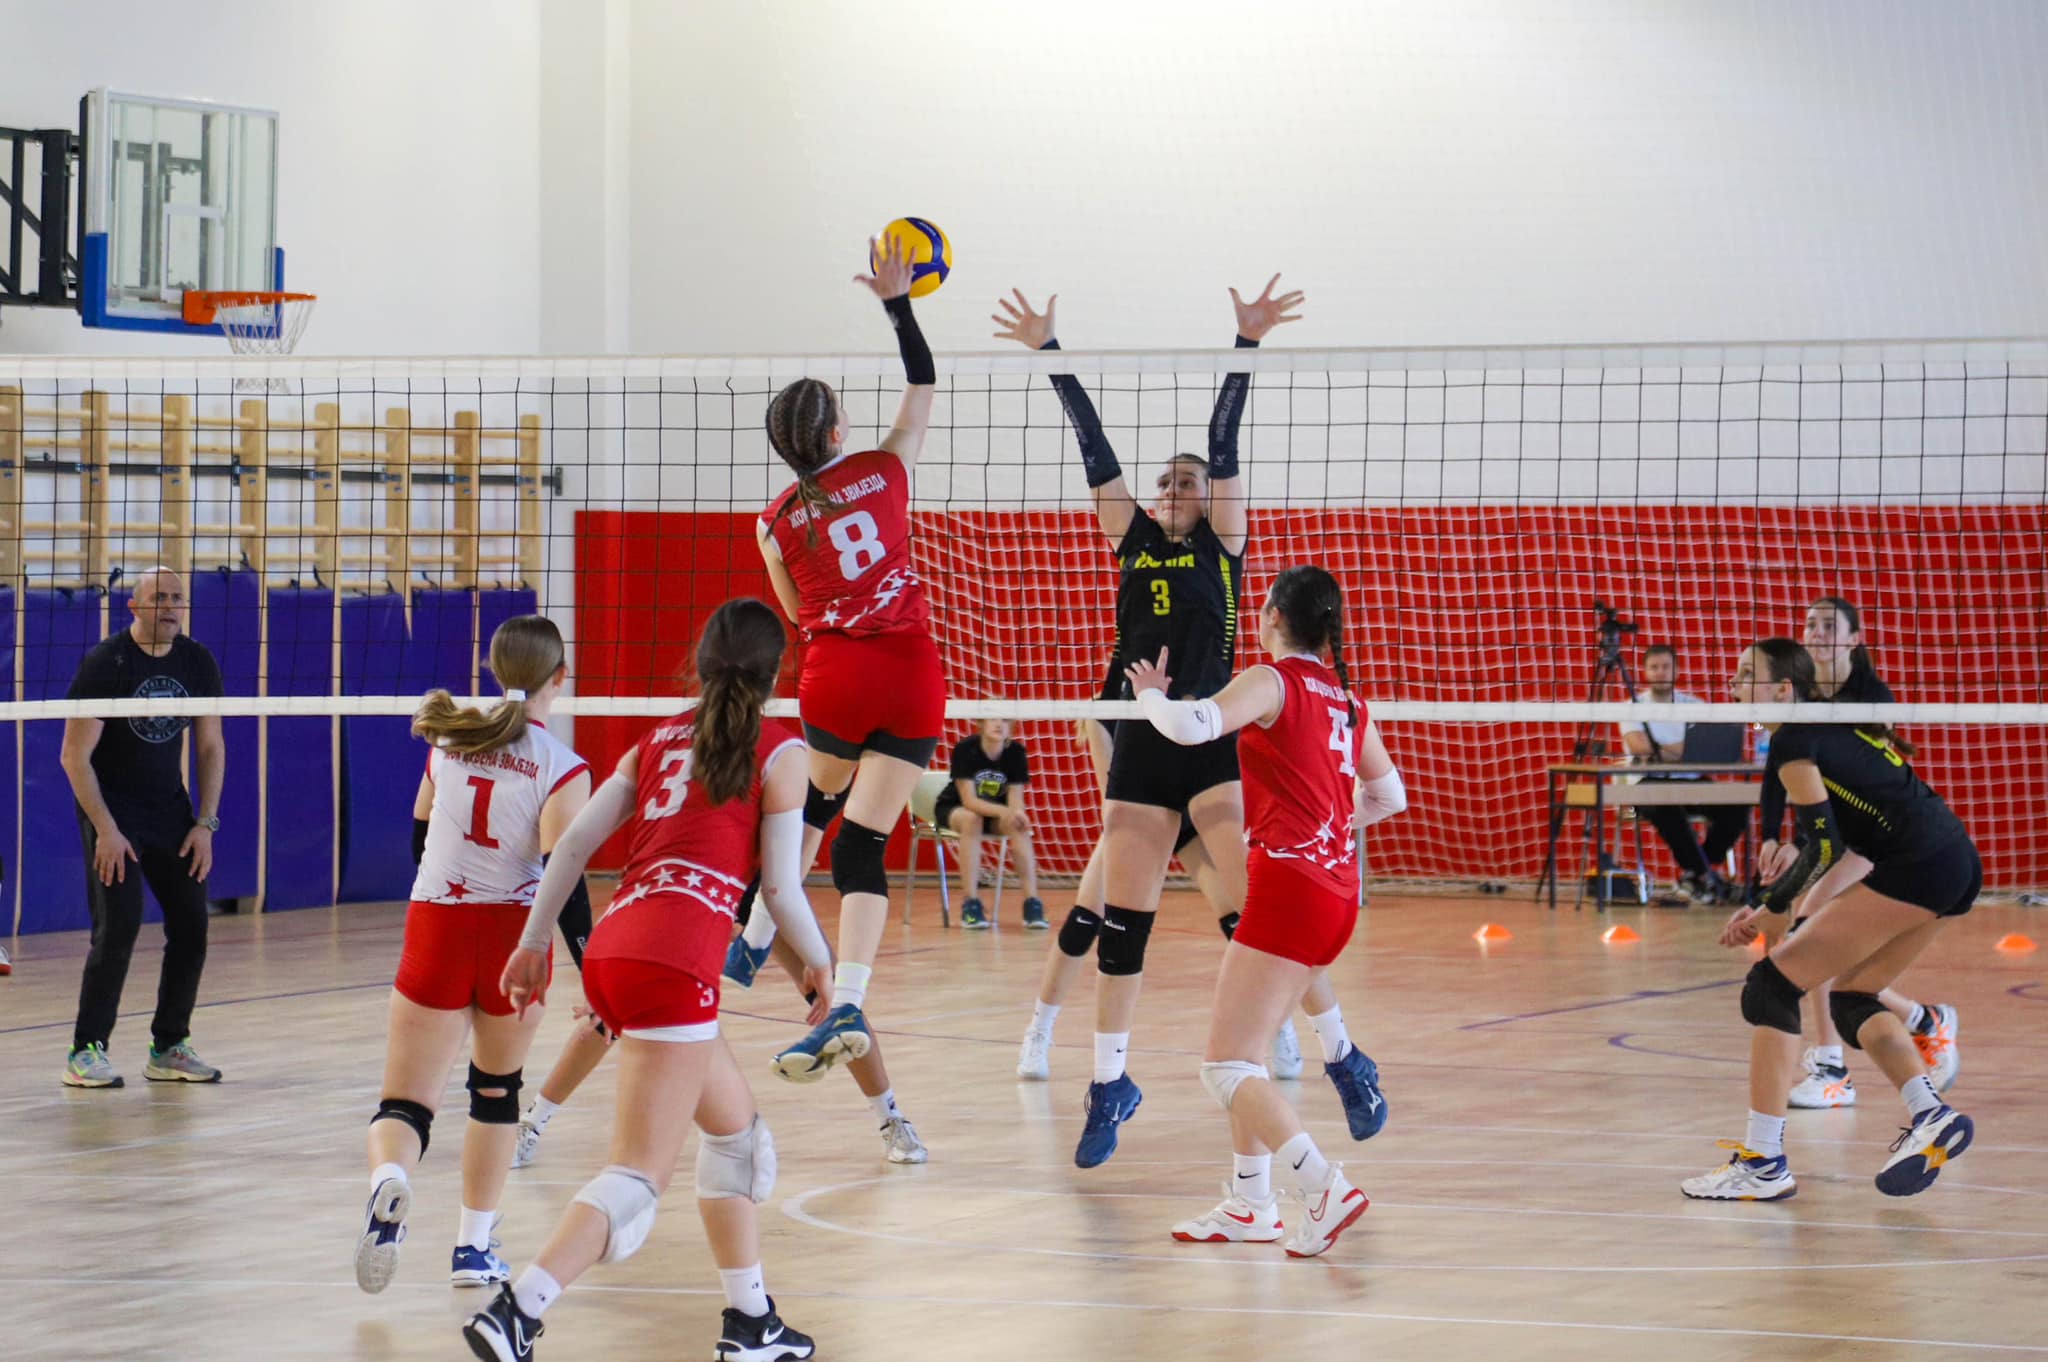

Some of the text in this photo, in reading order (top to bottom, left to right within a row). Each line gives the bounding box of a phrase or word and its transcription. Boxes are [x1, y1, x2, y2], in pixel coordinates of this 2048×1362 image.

[841, 473, 887, 503] ЗВИЈЕЗДА
[828, 510, 887, 581] 8
[1151, 579, 1171, 616] 3
[1327, 706, 1356, 778] 4
[464, 775, 500, 849] 1
[644, 748, 695, 820] 3
